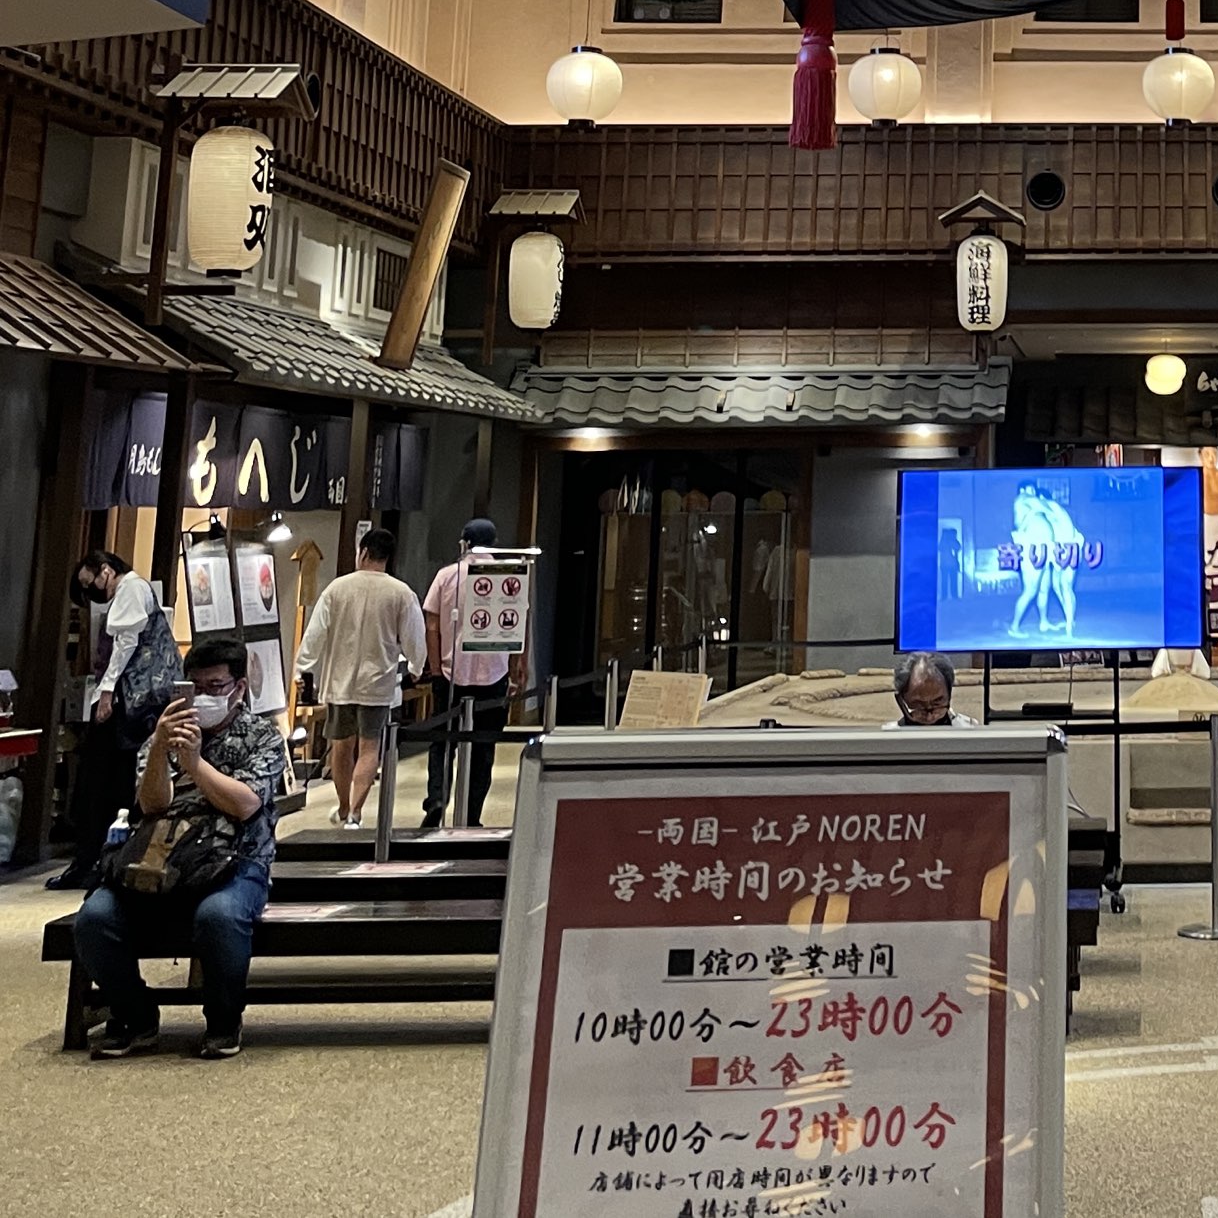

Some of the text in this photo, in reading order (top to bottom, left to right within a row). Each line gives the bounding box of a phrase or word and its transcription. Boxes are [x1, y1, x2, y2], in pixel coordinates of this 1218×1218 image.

[967, 242, 992, 324] 海鮮料理
[188, 415, 318, 506] もへじ
[997, 540, 1104, 571] 寄り切り
[608, 858, 953, 903] 営業時間のお知らせ
